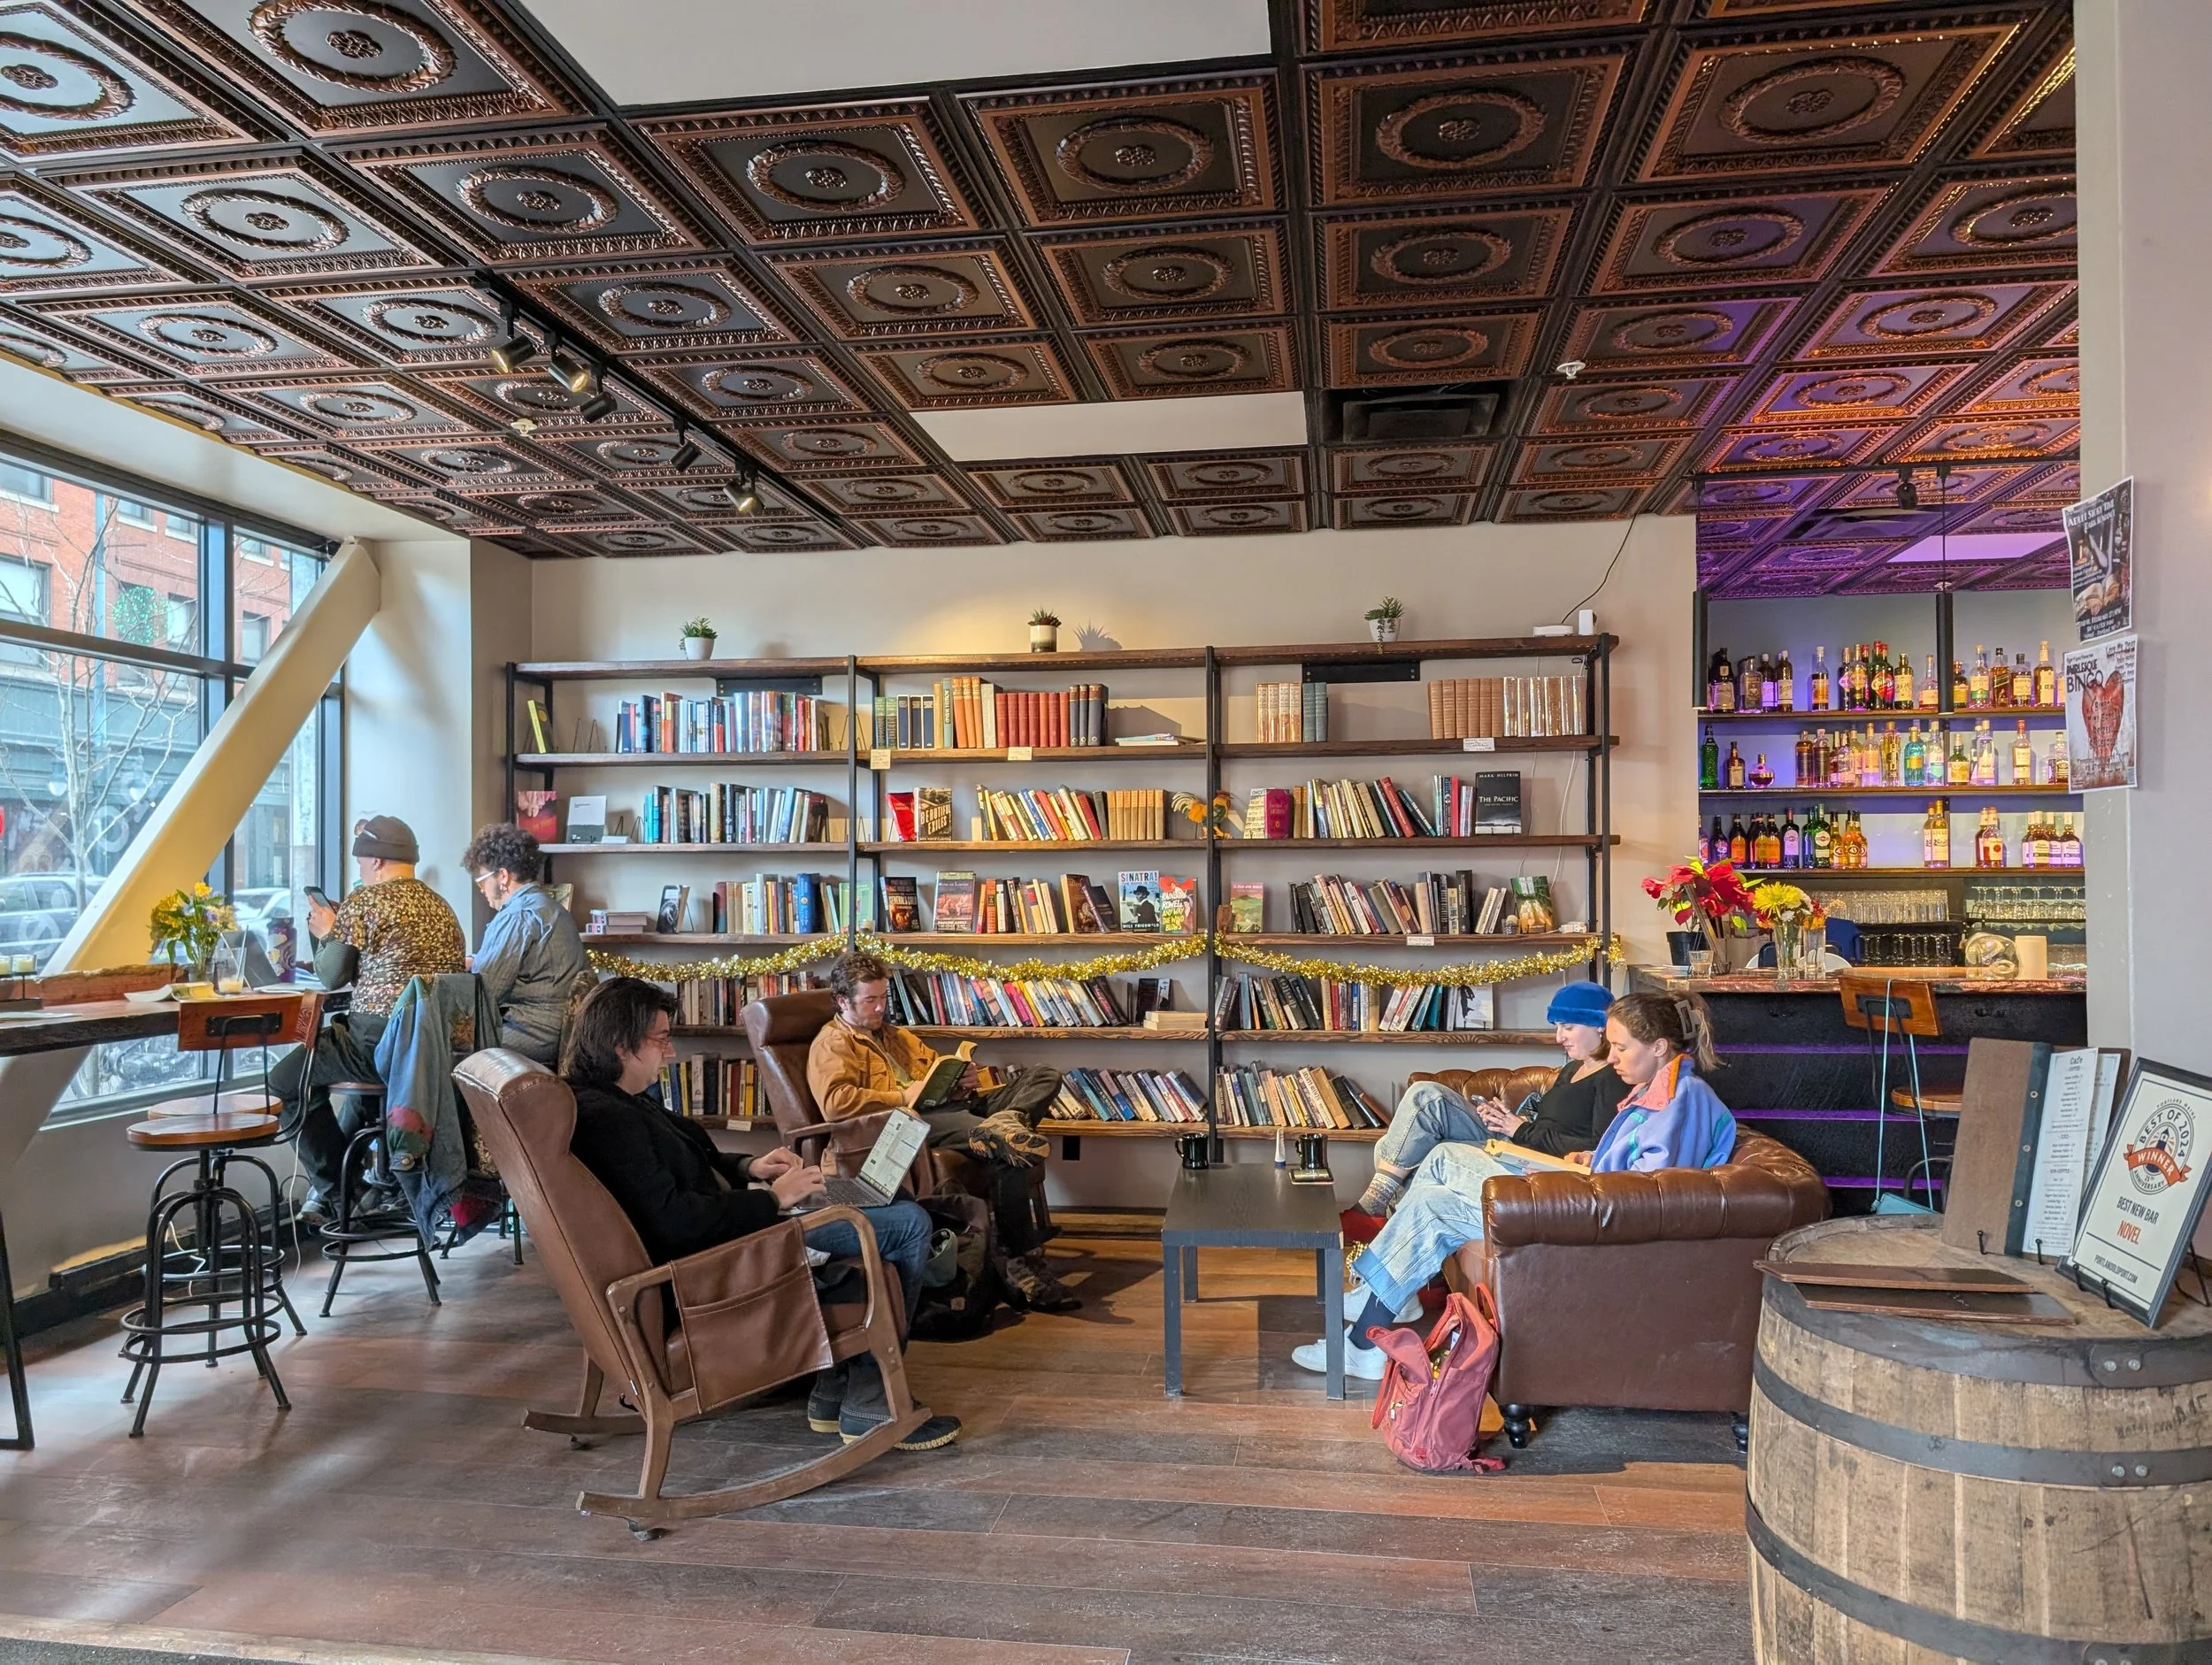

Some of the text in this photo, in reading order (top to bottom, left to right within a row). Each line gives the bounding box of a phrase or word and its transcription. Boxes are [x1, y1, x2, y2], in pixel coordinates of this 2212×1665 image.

[2067, 670, 2103, 693] BINGO
[920, 804, 951, 825] BEAUTIFUL
[927, 815, 948, 835] EXILES
[1120, 872, 1157, 882] SINATRA!
[1161, 890, 1187, 902] RAINBOW
[1161, 899, 1184, 909] ROWELL
[1164, 923, 1182, 932] BLOWS
[2139, 1109, 2190, 1158] BEST OF 2024
[2138, 1151, 2175, 1176] WINNER
[2134, 1170, 2165, 1190] ANNIVERSARY
[2116, 1196, 2160, 1224] BEST NEW BAR
[2116, 1220, 2141, 1246] NOVEL
